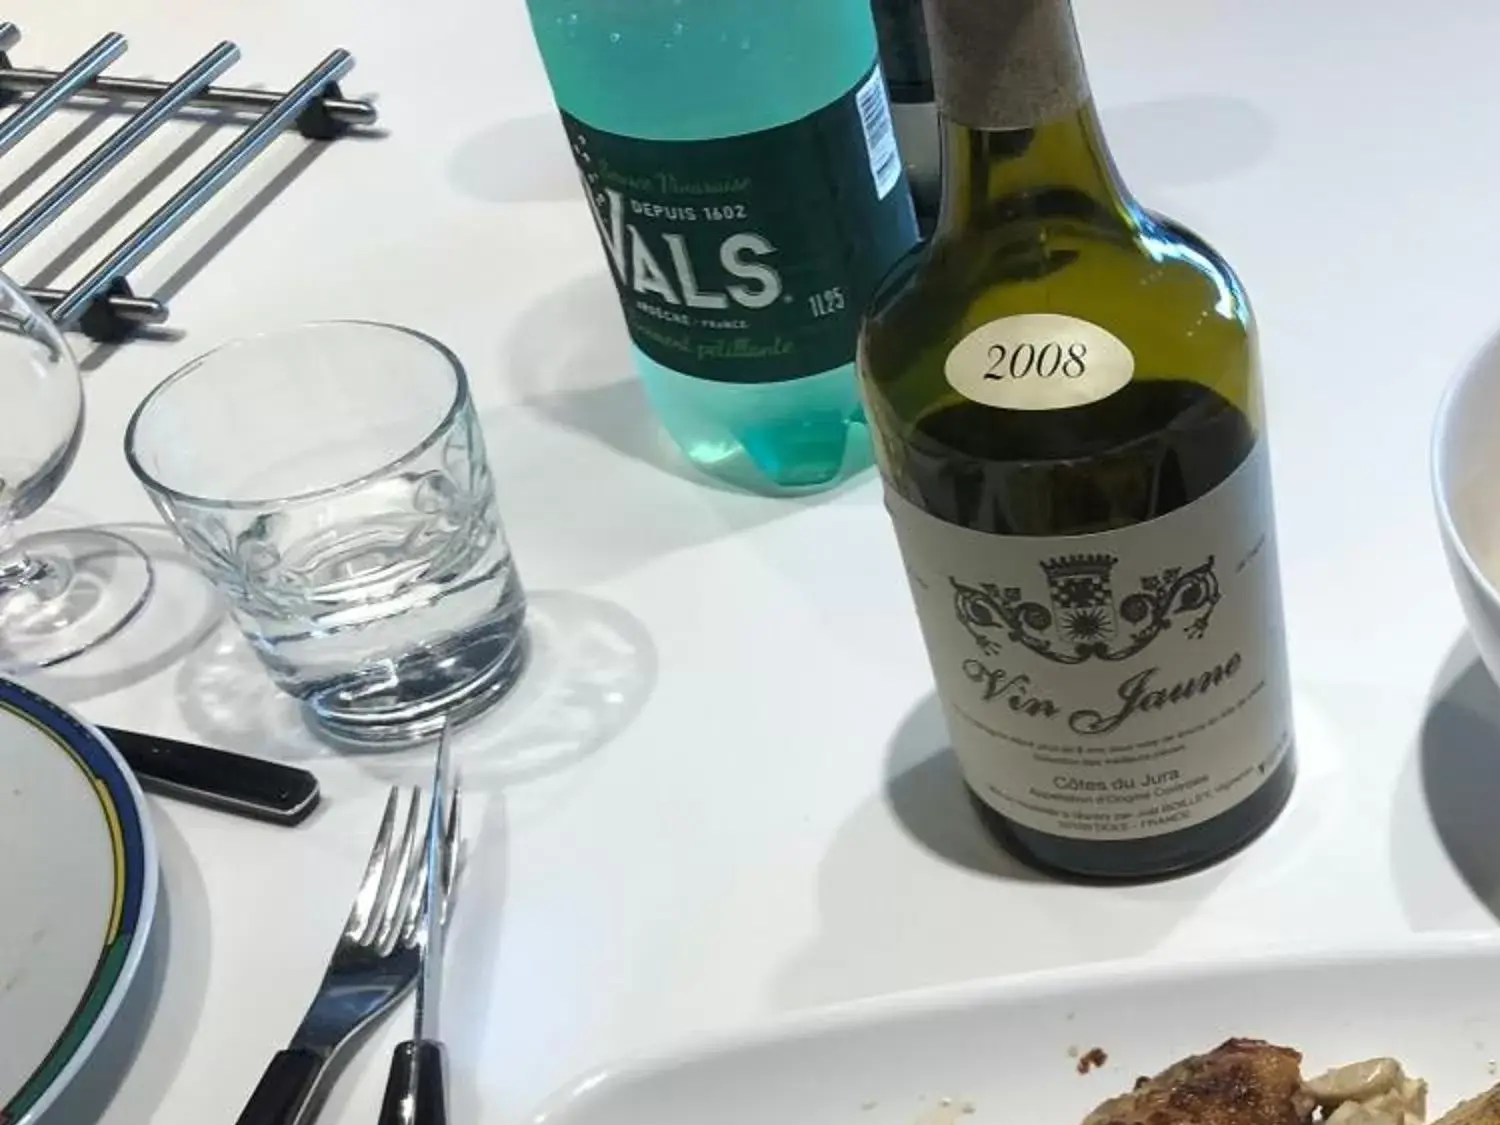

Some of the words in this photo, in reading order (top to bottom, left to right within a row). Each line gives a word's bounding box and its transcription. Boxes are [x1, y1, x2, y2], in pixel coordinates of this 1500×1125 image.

[630, 198, 697, 221] DEPUIS
[702, 204, 748, 221] 1602
[583, 177, 784, 308] VALS
[983, 342, 1088, 381] 2008
[962, 658, 1061, 721] Vin
[1067, 652, 1243, 736] Jaune
[1052, 775, 1108, 792] Côtes
[1111, 777, 1136, 791] du
[1140, 769, 1180, 788] Jura
